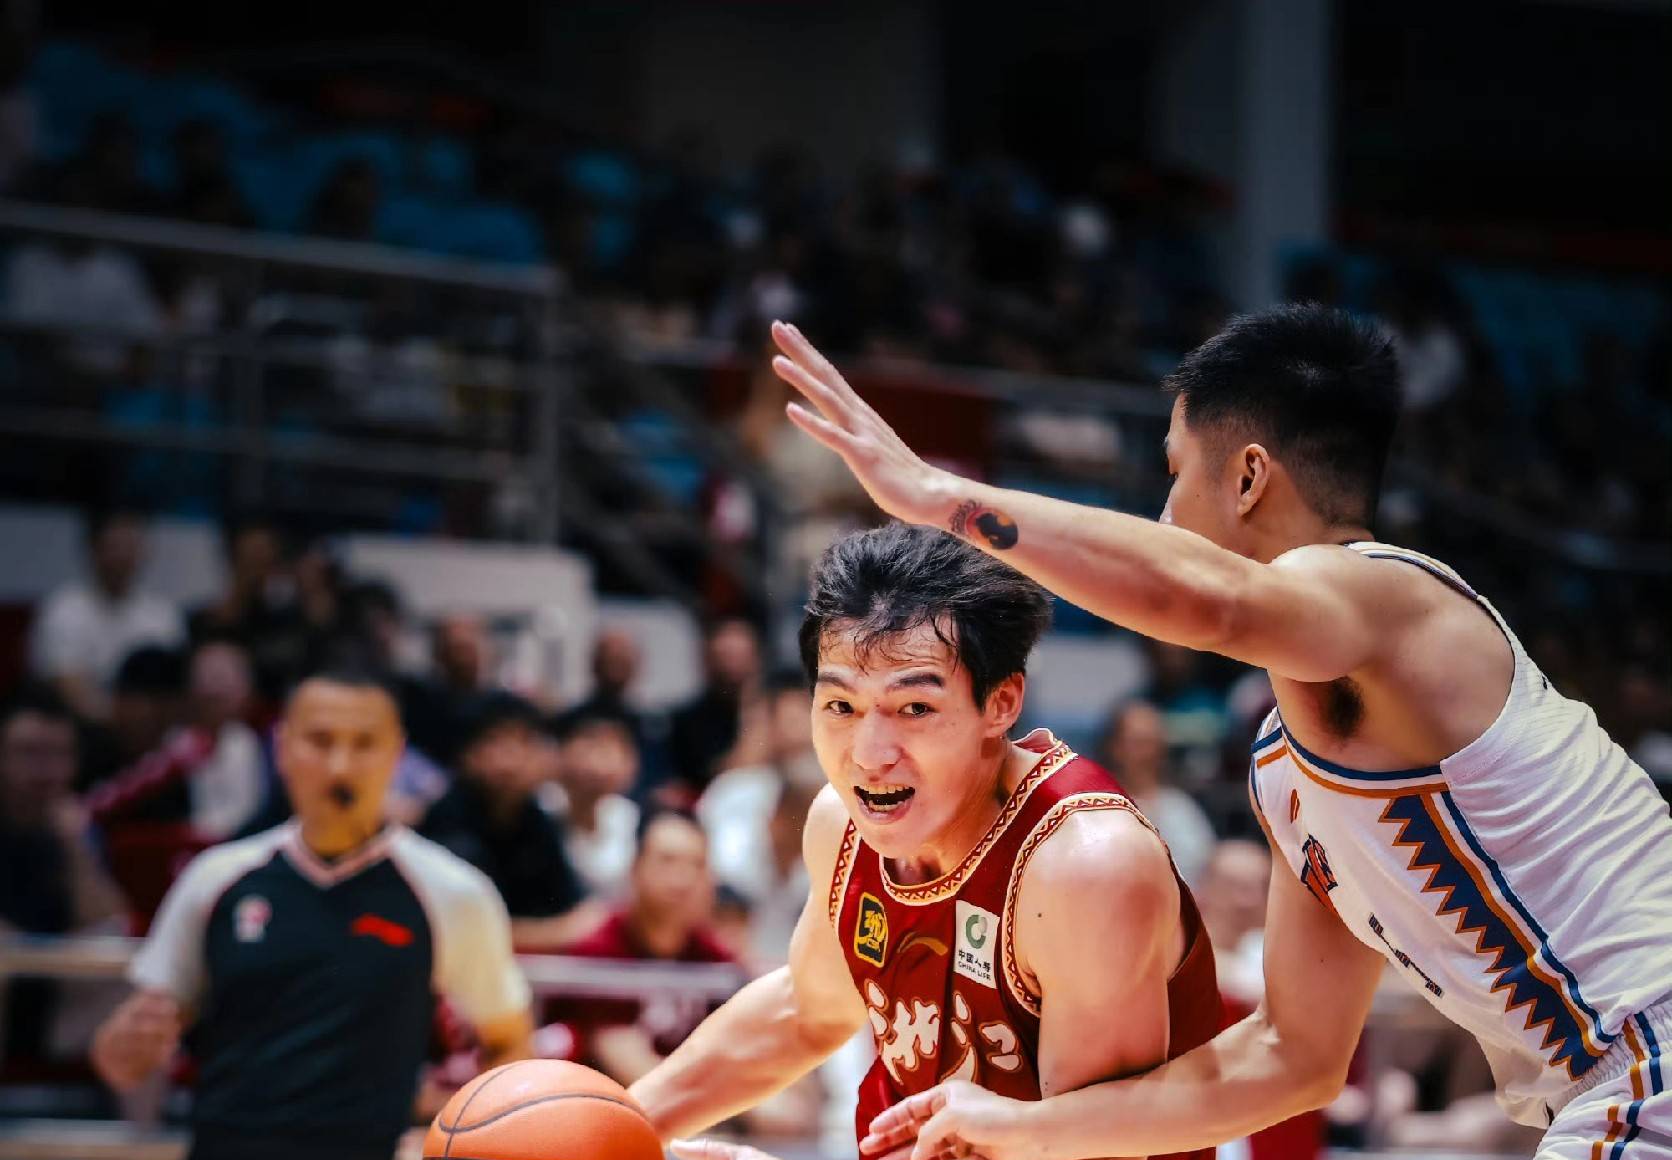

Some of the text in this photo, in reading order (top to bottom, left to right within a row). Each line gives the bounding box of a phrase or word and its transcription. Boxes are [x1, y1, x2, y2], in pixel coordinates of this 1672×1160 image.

[957, 948, 992, 973] 中国人寿
[957, 959, 992, 981] CHINA LIFE
